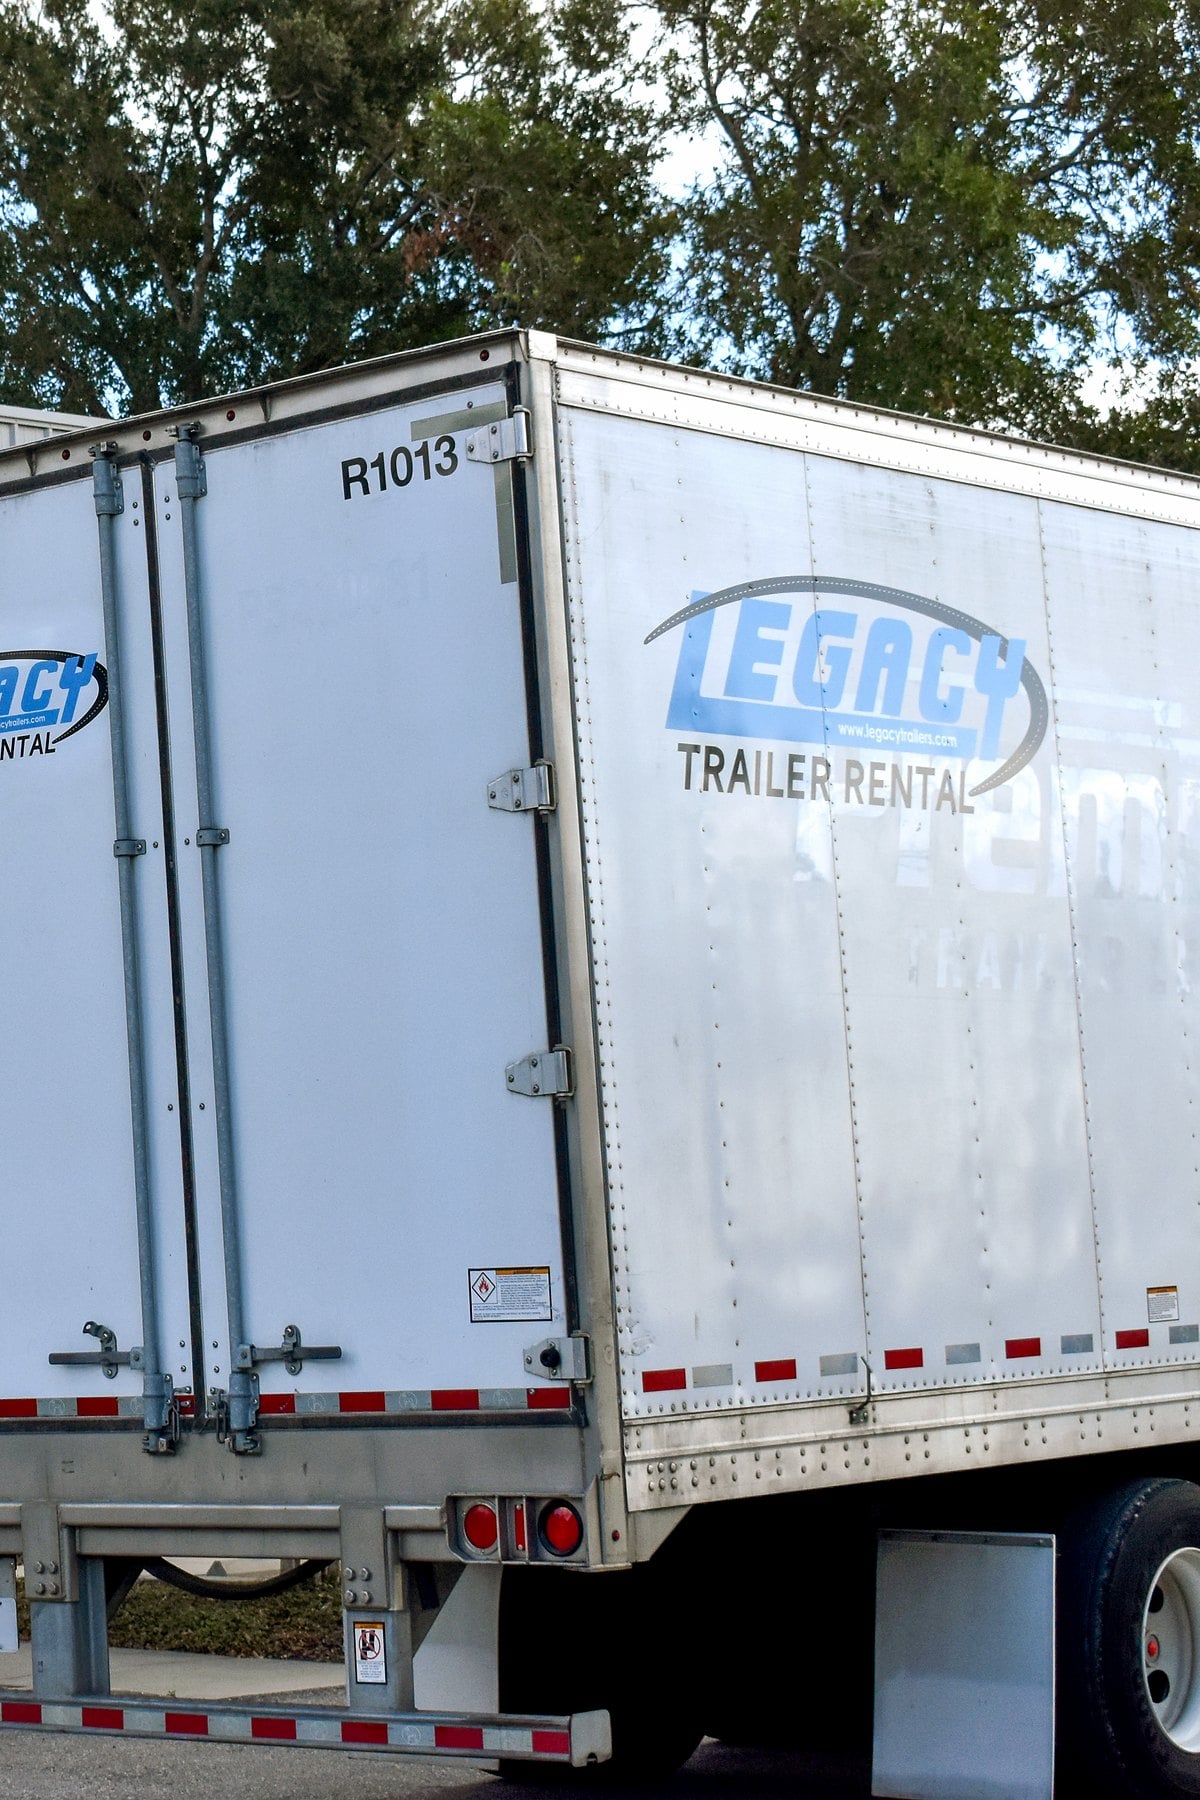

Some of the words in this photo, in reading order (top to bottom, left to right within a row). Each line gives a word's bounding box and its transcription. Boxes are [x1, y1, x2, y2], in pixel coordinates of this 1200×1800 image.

[341, 435, 458, 500] R1013
[665, 590, 1026, 760] LEGACY
[838, 722, 958, 748] www.legacytrailers.com
[677, 742, 831, 801] TRAILER
[844, 758, 975, 815] RENTAL
